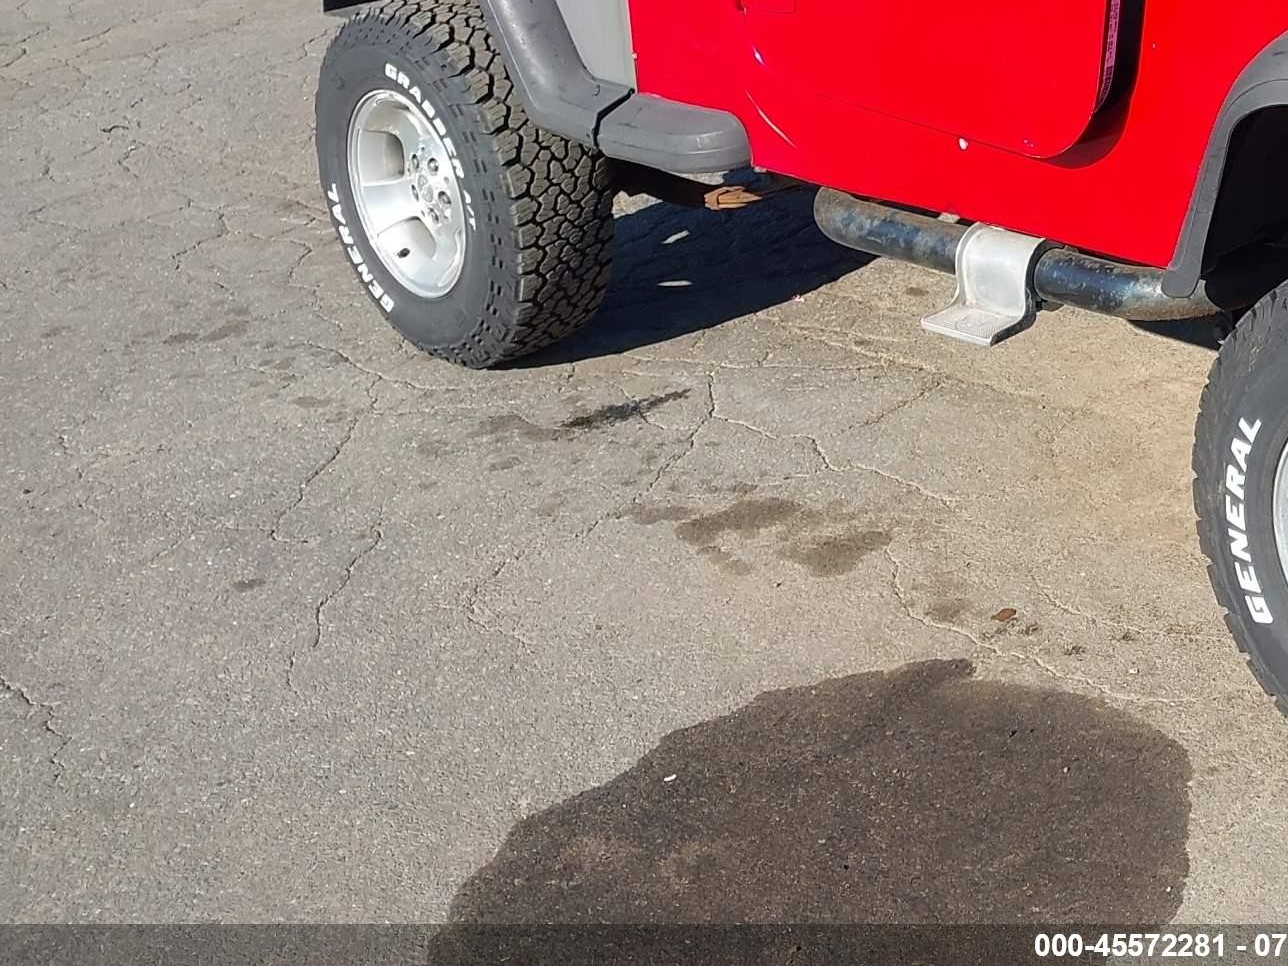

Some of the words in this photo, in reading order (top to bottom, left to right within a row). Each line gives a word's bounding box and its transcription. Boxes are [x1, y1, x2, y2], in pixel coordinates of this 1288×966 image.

[384, 63, 465, 179] GRABBER
[328, 184, 394, 312] GENERAL
[1224, 417, 1274, 624] GENERAL
